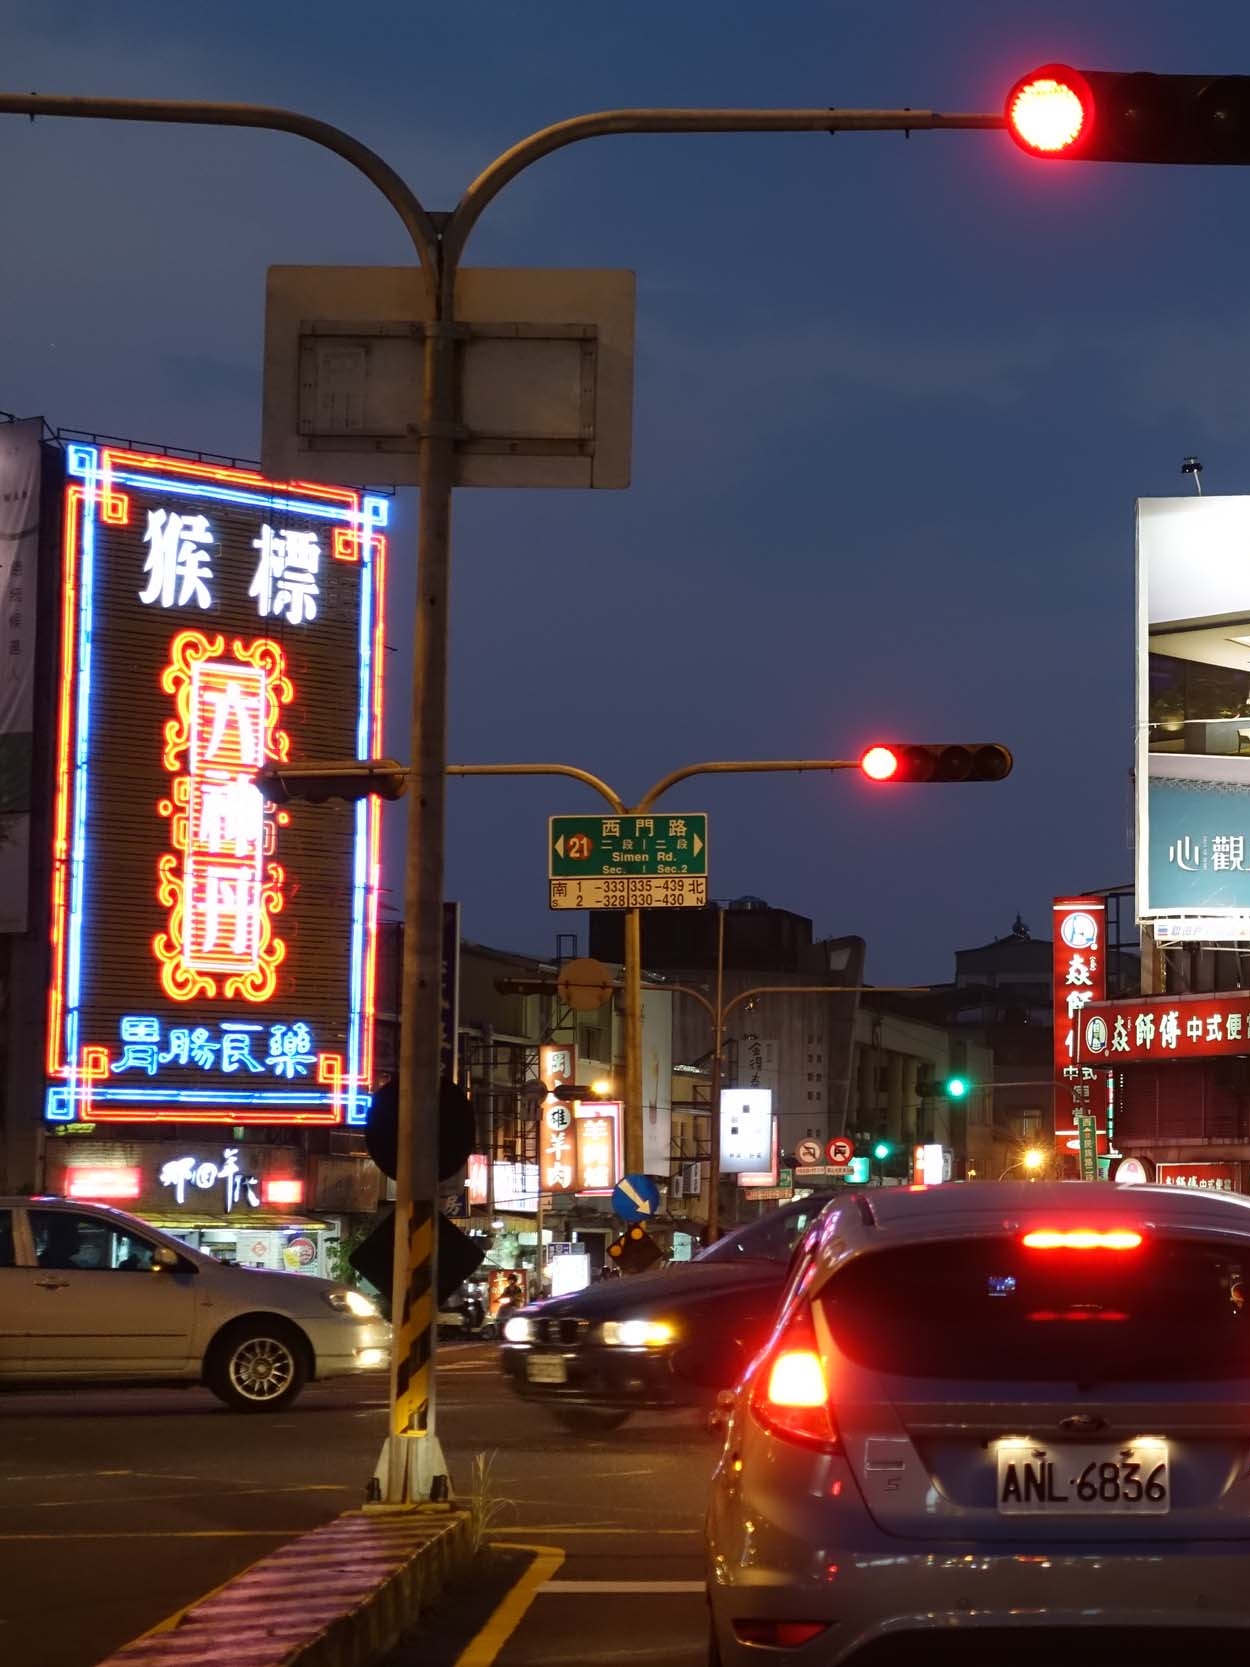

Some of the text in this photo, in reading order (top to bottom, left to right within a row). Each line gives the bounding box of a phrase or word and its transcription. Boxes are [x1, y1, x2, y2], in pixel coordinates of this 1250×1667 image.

[138, 508, 321, 625] 猴標
[602, 819, 687, 837] 西門路
[569, 837, 588, 858] 21
[612, 851, 677, 862] Simen Rd.
[552, 882, 567, 898] 南
[630, 880, 684, 893] 335-439
[688, 880, 704, 895] 北
[630, 894, 684, 906] 330-430
[111, 1017, 317, 1078] 胃腸良藥
